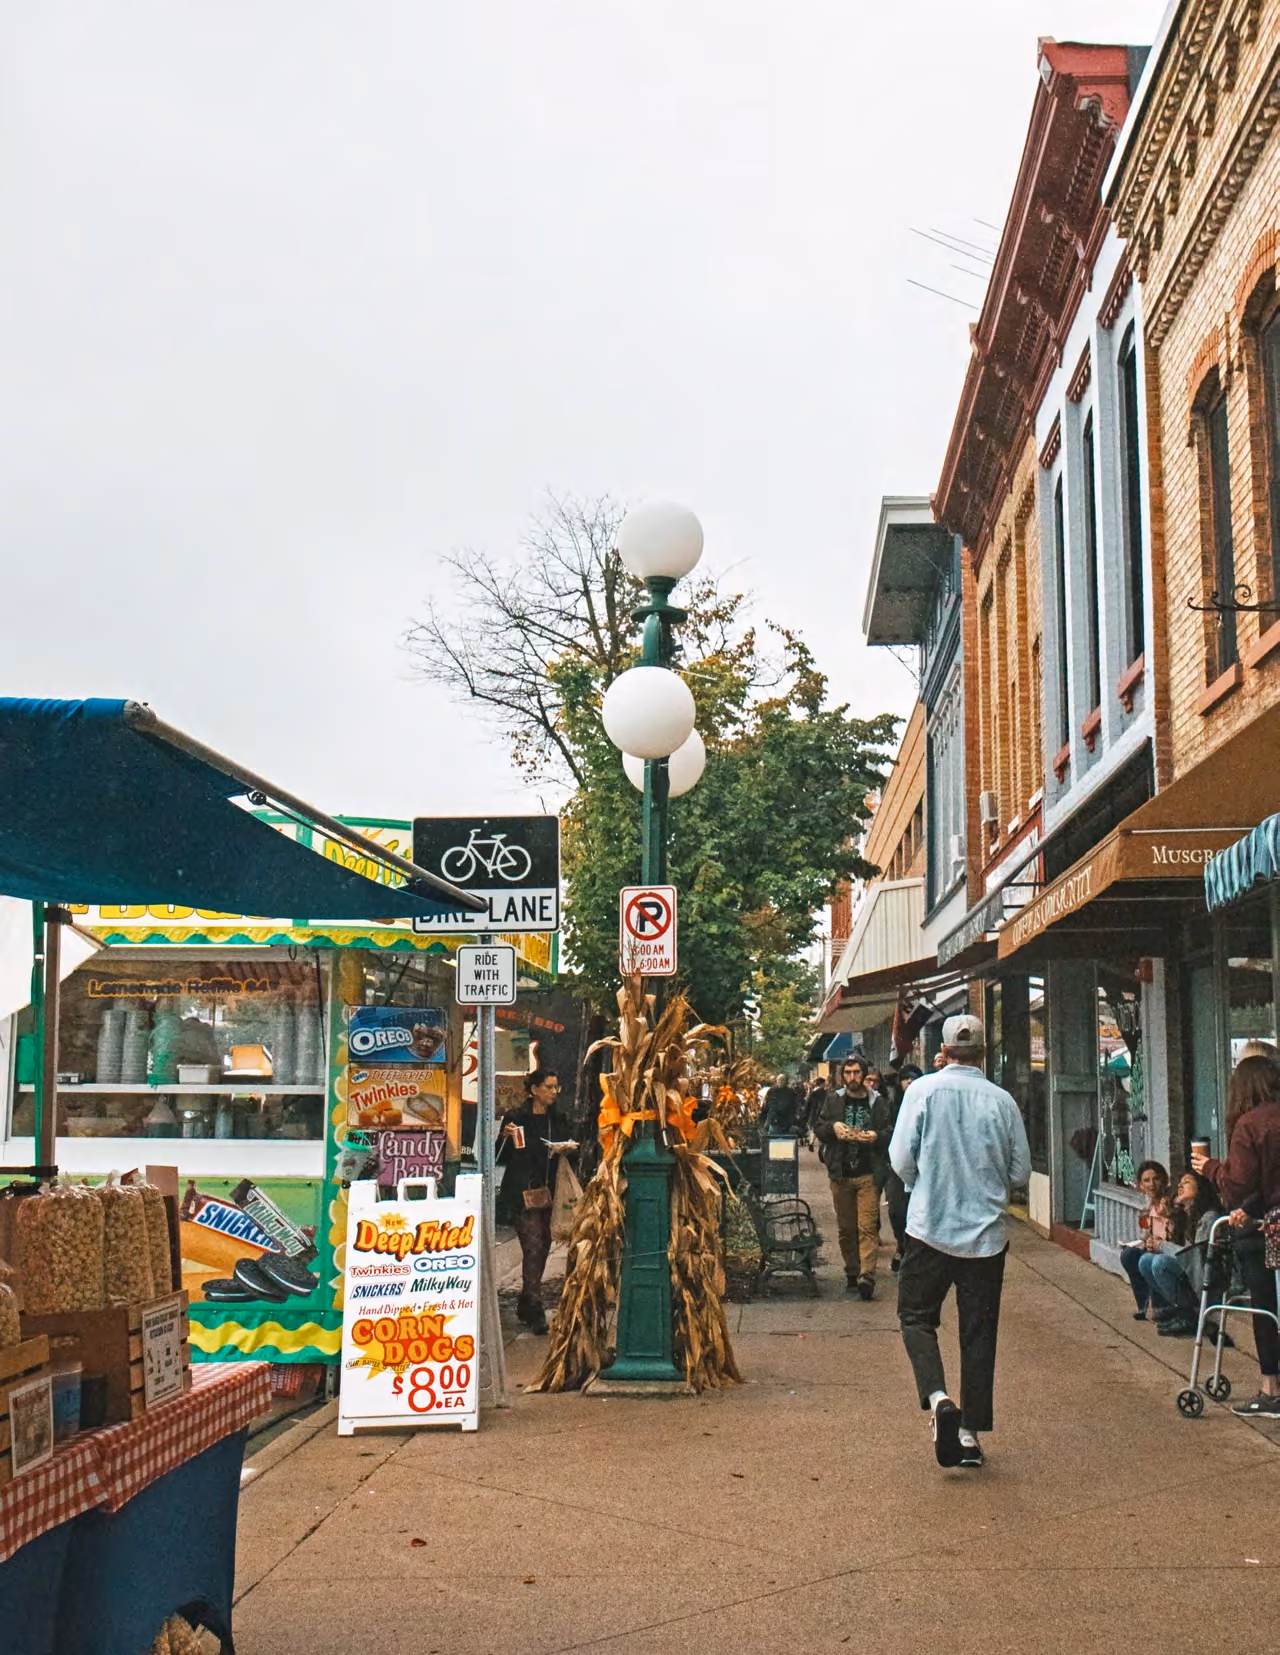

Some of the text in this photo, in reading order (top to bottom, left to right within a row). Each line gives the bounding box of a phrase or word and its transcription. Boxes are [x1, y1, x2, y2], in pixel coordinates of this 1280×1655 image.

[489, 896, 552, 923] LANE
[653, 944, 664, 955] AM
[474, 954, 498, 965] RIDE
[659, 957, 670, 968] AM
[474, 970, 499, 980] WITH
[464, 985, 508, 996] TRAFFIC
[402, 1070, 433, 1081] FRIED
[350, 1082, 419, 1111] Twinkies
[379, 1131, 446, 1162] Candy
[197, 1202, 277, 1249] SNICKE
[354, 1215, 475, 1261] Deep Fried
[351, 1255, 475, 1277] Twinkies OREO
[352, 1282, 404, 1298] SNICKERS
[359, 1300, 473, 1316] Hand Dipped Fresh & Hot
[352, 1314, 446, 1345] CORN
[382, 1335, 475, 1366] DOGS
